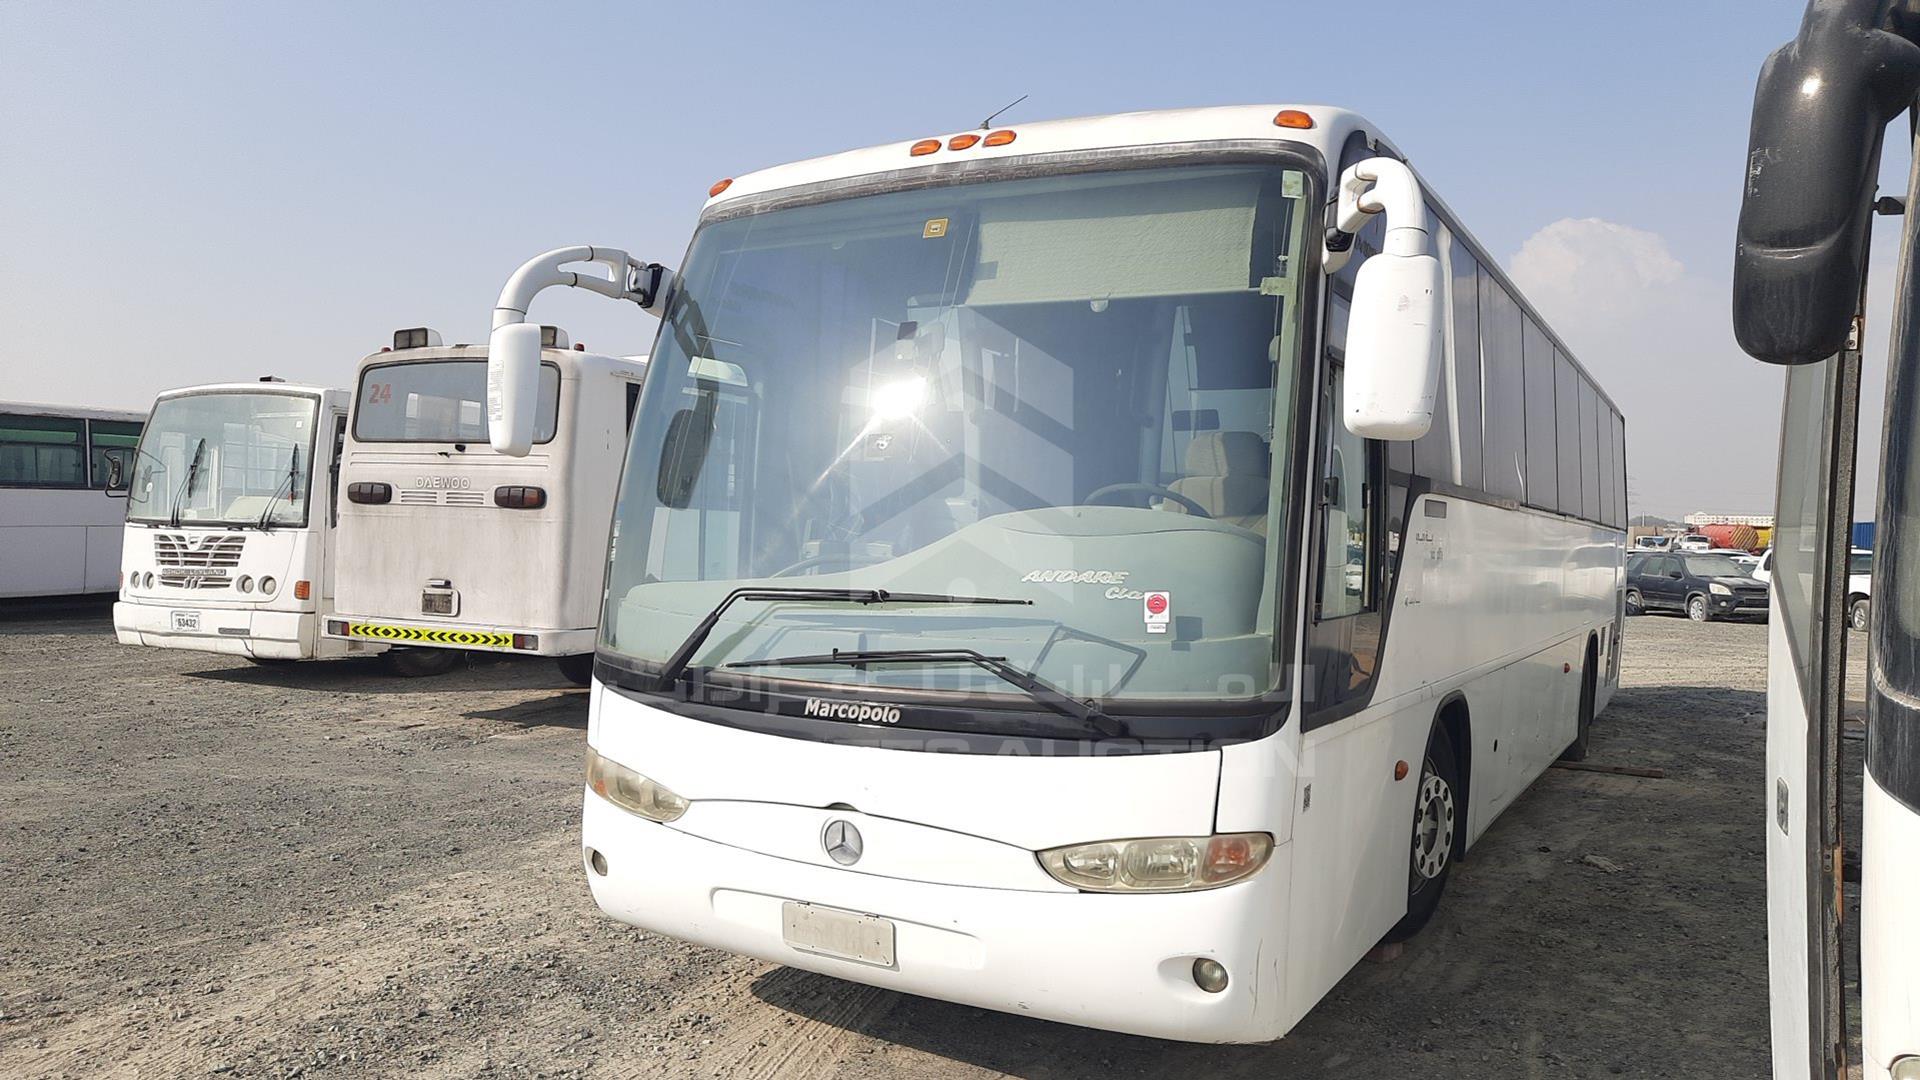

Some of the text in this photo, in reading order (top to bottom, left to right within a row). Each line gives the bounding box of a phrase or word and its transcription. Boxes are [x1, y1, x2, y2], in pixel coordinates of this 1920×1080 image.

[369, 384, 392, 404] 24
[416, 476, 470, 490] DAEWOO
[1020, 570, 1130, 585] ANDARE
[804, 697, 902, 724] Marcopolo
